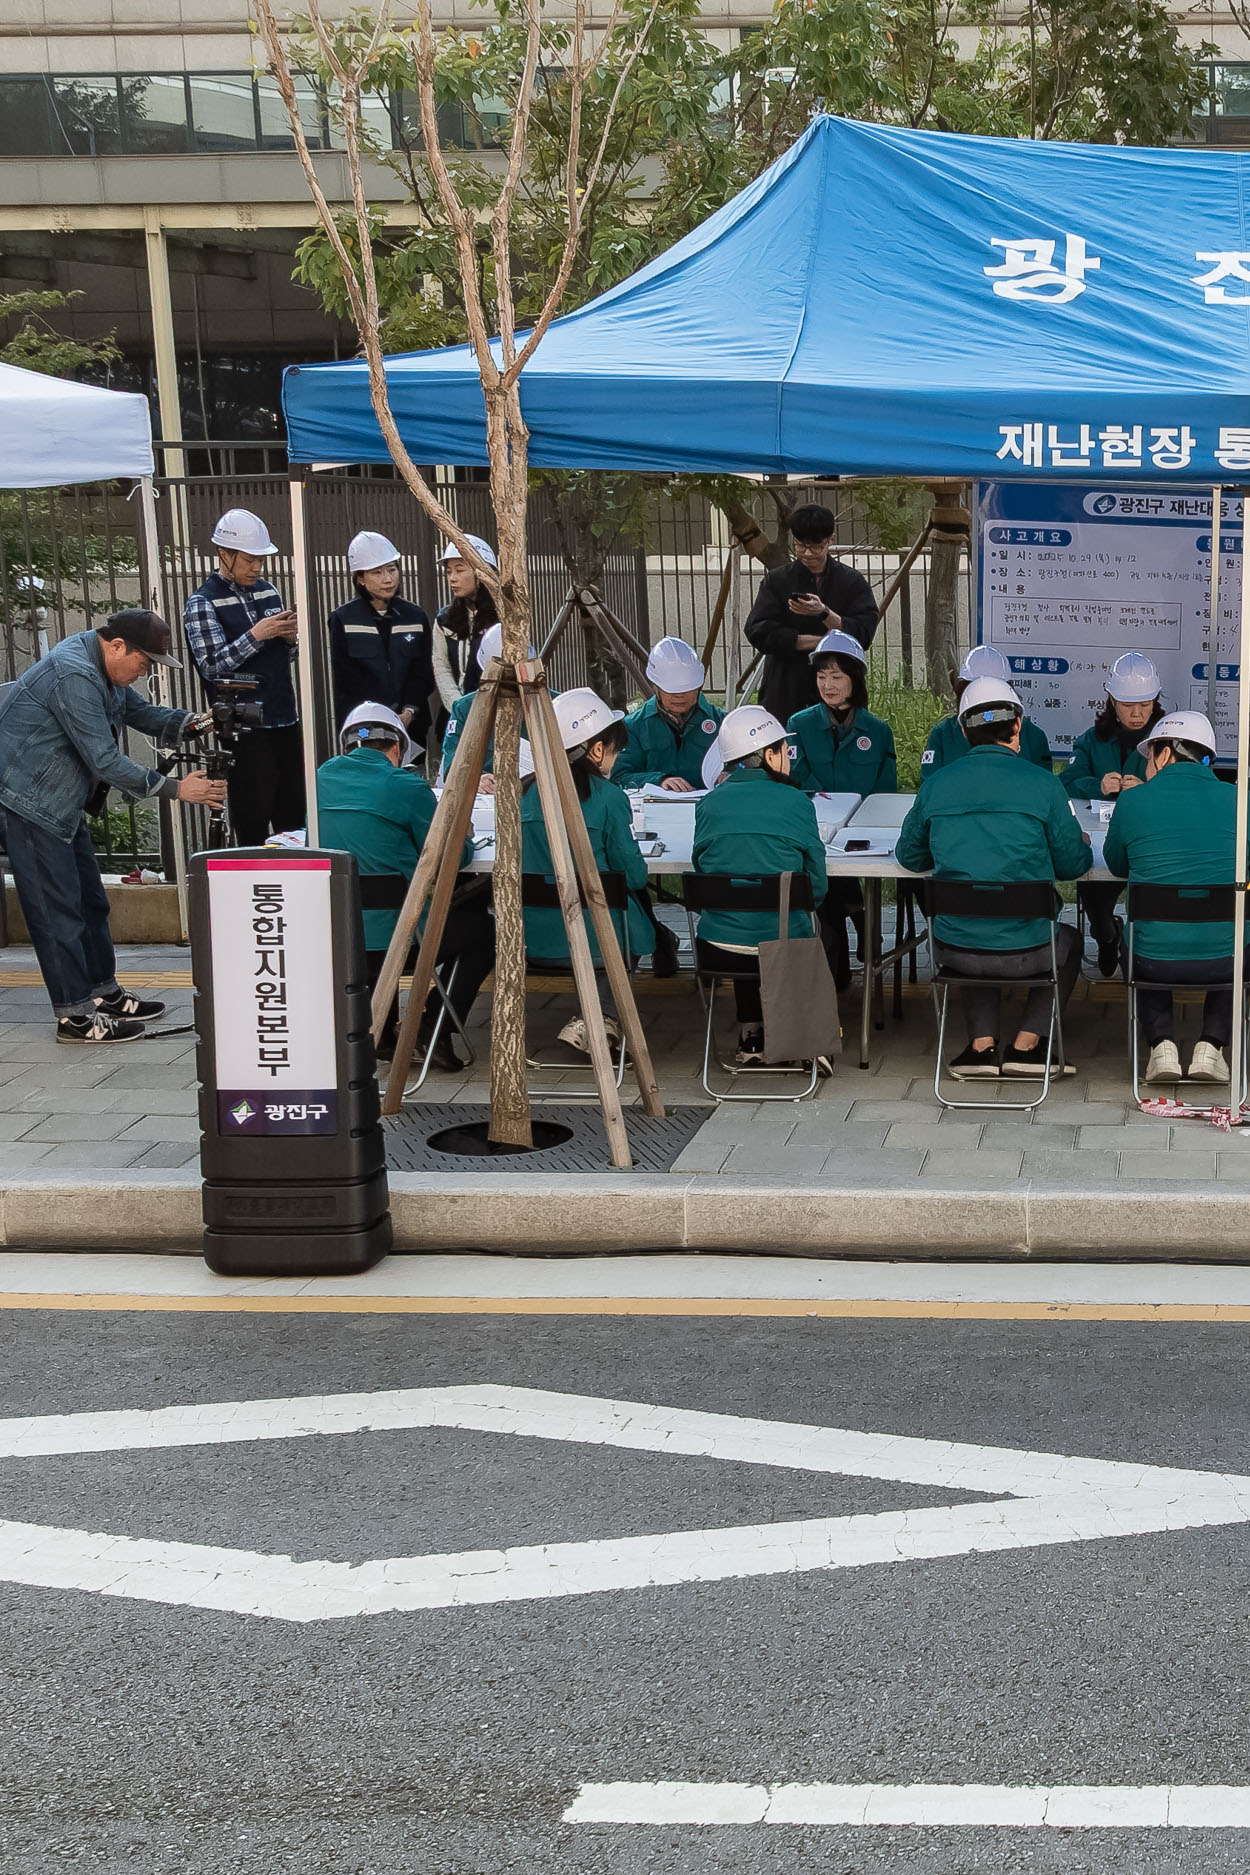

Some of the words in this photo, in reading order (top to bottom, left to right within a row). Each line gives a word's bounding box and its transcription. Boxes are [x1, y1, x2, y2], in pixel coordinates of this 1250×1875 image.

[996, 422, 1196, 470] 재난현장
[1119, 498, 1165, 514] 광진구
[251, 884, 290, 1077] 통합지원본부
[264, 1103, 329, 1121] 광진구
